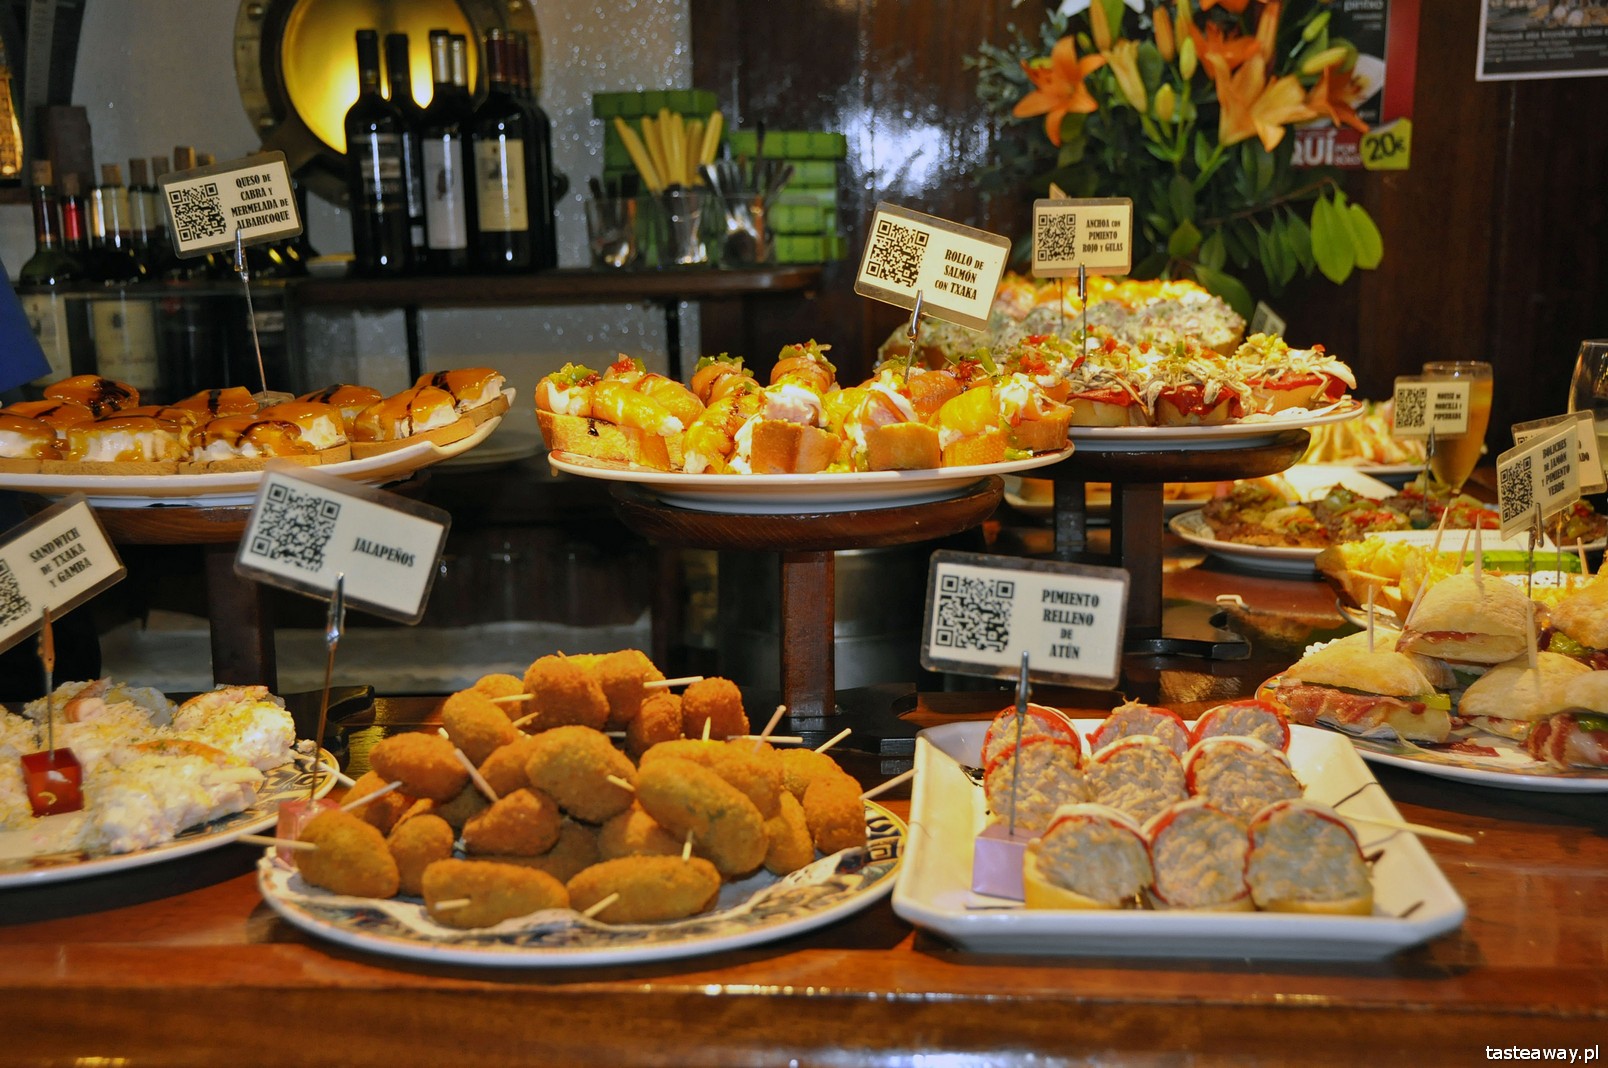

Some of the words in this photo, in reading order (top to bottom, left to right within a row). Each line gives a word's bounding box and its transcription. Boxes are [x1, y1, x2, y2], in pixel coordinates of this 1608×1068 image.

[236, 174, 260, 188] QUESO
[262, 174, 272, 182] DE
[240, 187, 266, 201] CABRA
[268, 188, 273, 196] Y
[231, 199, 278, 217] MERMELADA
[279, 198, 288, 207] DE
[236, 210, 290, 230] ALBARICOQUE
[1086, 219, 1110, 228] ANCHOA
[1088, 231, 1118, 240] PIMIENTO
[1082, 244, 1098, 252] ROJO
[1105, 242, 1123, 252] GULAS
[944, 249, 973, 266] ROLLO
[974, 260, 984, 270] DE
[944, 264, 977, 284] SALMÓN
[934, 280, 948, 290] CON
[950, 282, 977, 300] TXAKA
[1546, 464, 1571, 485] PIMIENTO
[1548, 480, 1565, 496] VERDE
[30, 527, 80, 562] SANDWICH
[352, 537, 416, 567] JALAPEÑOS
[40, 564, 53, 576] DE
[51, 543, 86, 568] TXAKA
[49, 579, 57, 588] Y
[57, 557, 92, 583] GAMBA
[1042, 589, 1099, 608] PIMIENTO
[1043, 608, 1094, 626] RELLENO
[1060, 628, 1073, 640] DE
[1050, 643, 1080, 659] ATÚN
